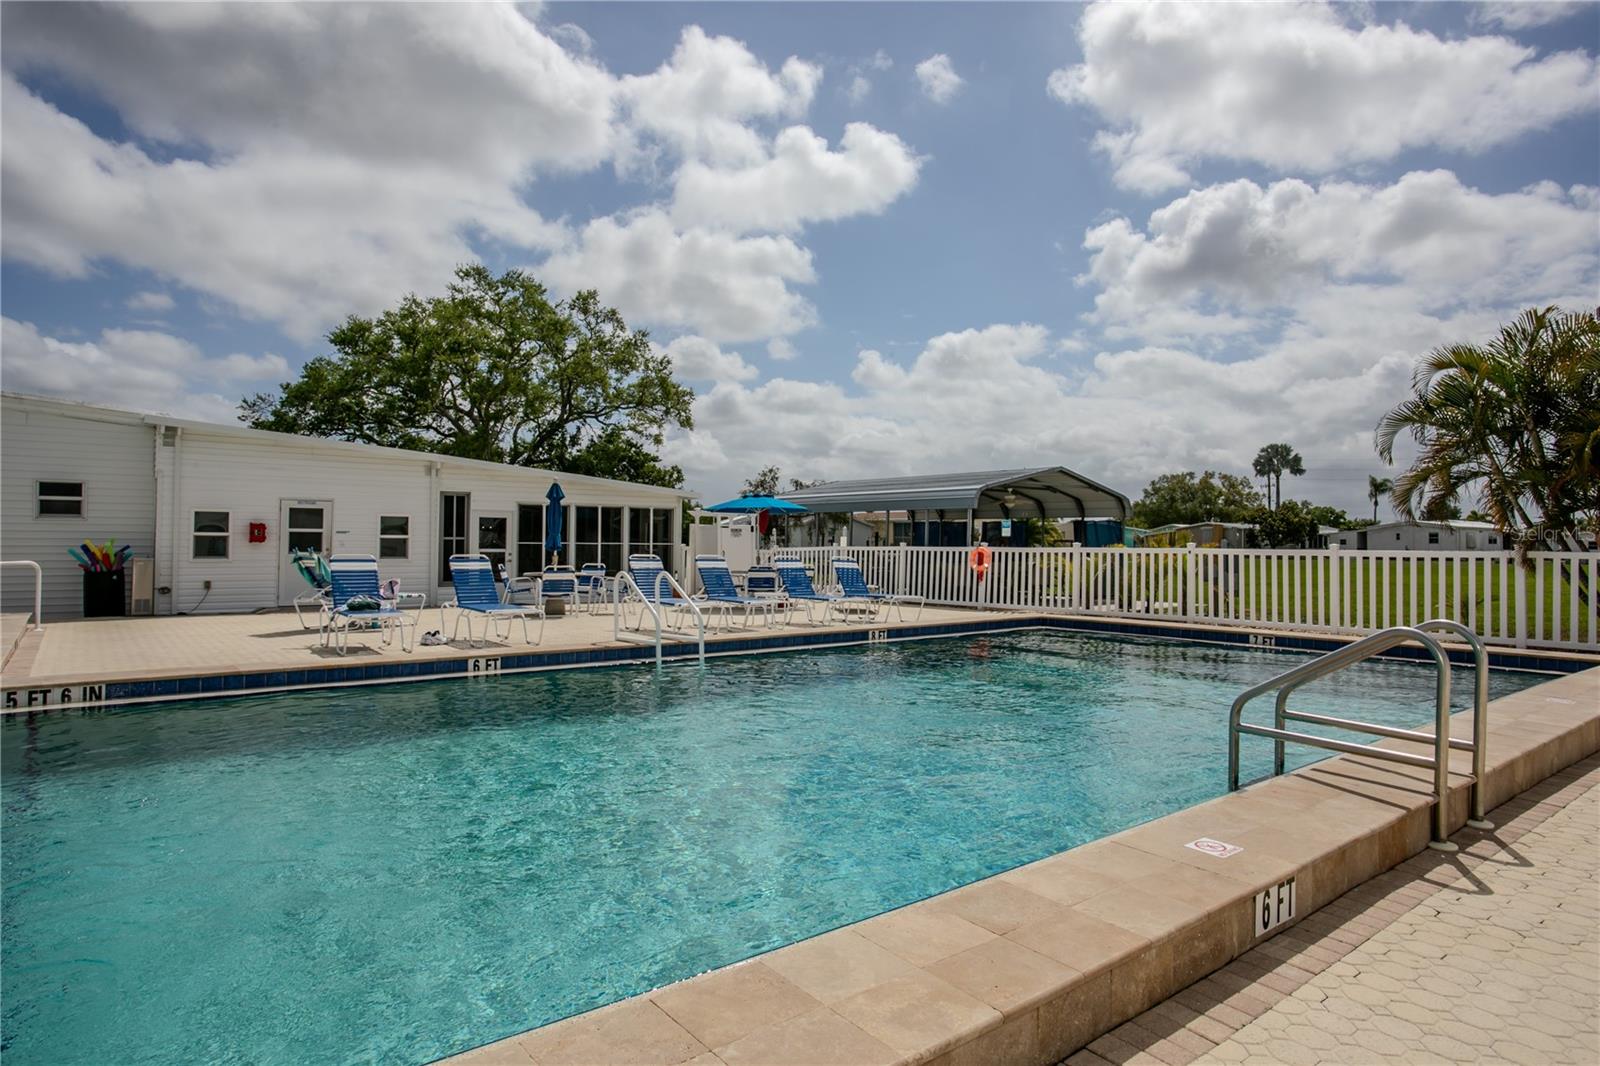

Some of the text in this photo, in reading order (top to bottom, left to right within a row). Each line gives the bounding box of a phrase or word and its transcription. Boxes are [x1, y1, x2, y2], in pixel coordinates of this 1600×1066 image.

[878, 630, 887, 640] FT
[1262, 636, 1274, 646] FT
[473, 658, 499, 671] 6 FT
[6, 686, 103, 708] 5 FT 6 IN
[1262, 876, 1295, 930] 6 FT
